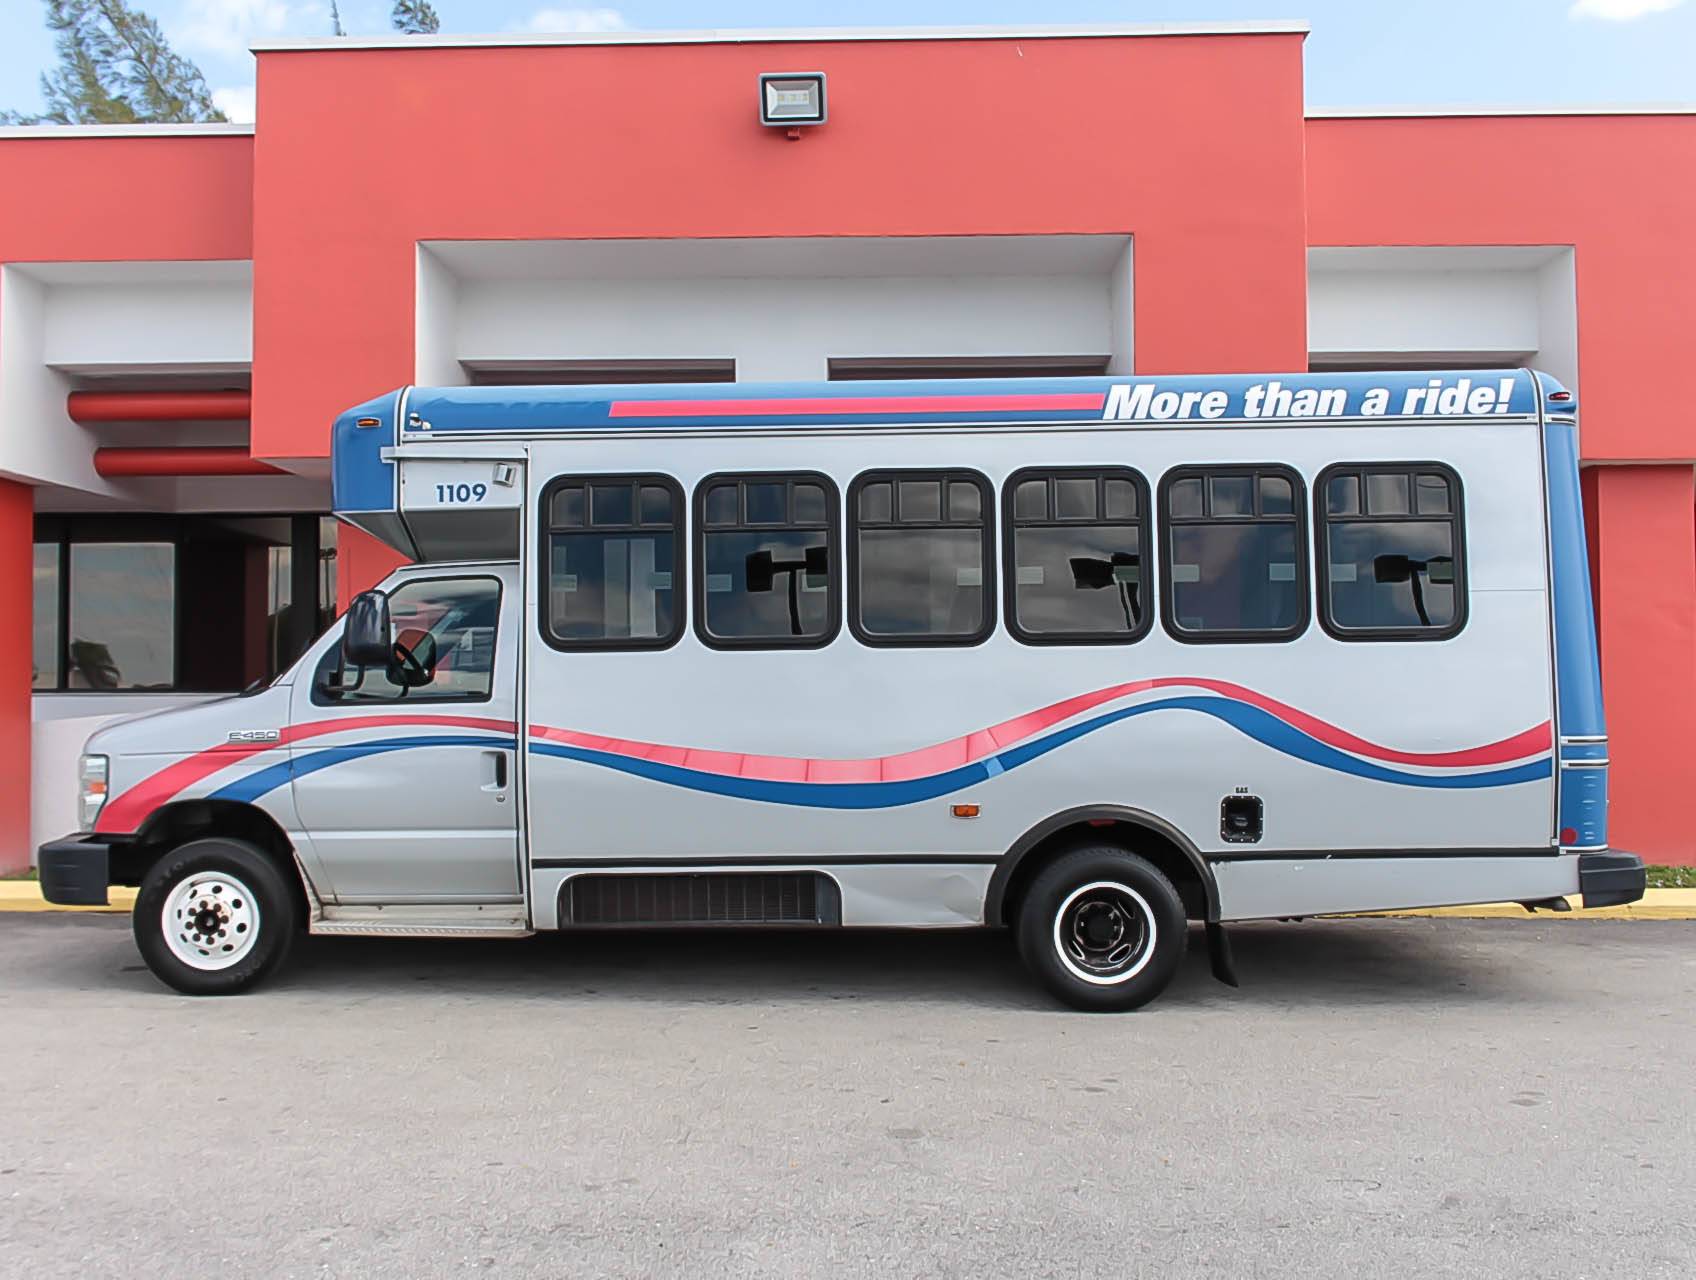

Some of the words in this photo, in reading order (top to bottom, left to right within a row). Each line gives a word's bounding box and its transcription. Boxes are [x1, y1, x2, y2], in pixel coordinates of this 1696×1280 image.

[1103, 384, 1229, 420] More
[1243, 381, 1348, 418] than
[1360, 388, 1390, 416] a
[1401, 378, 1515, 415] ride!
[436, 483, 487, 503] 1109
